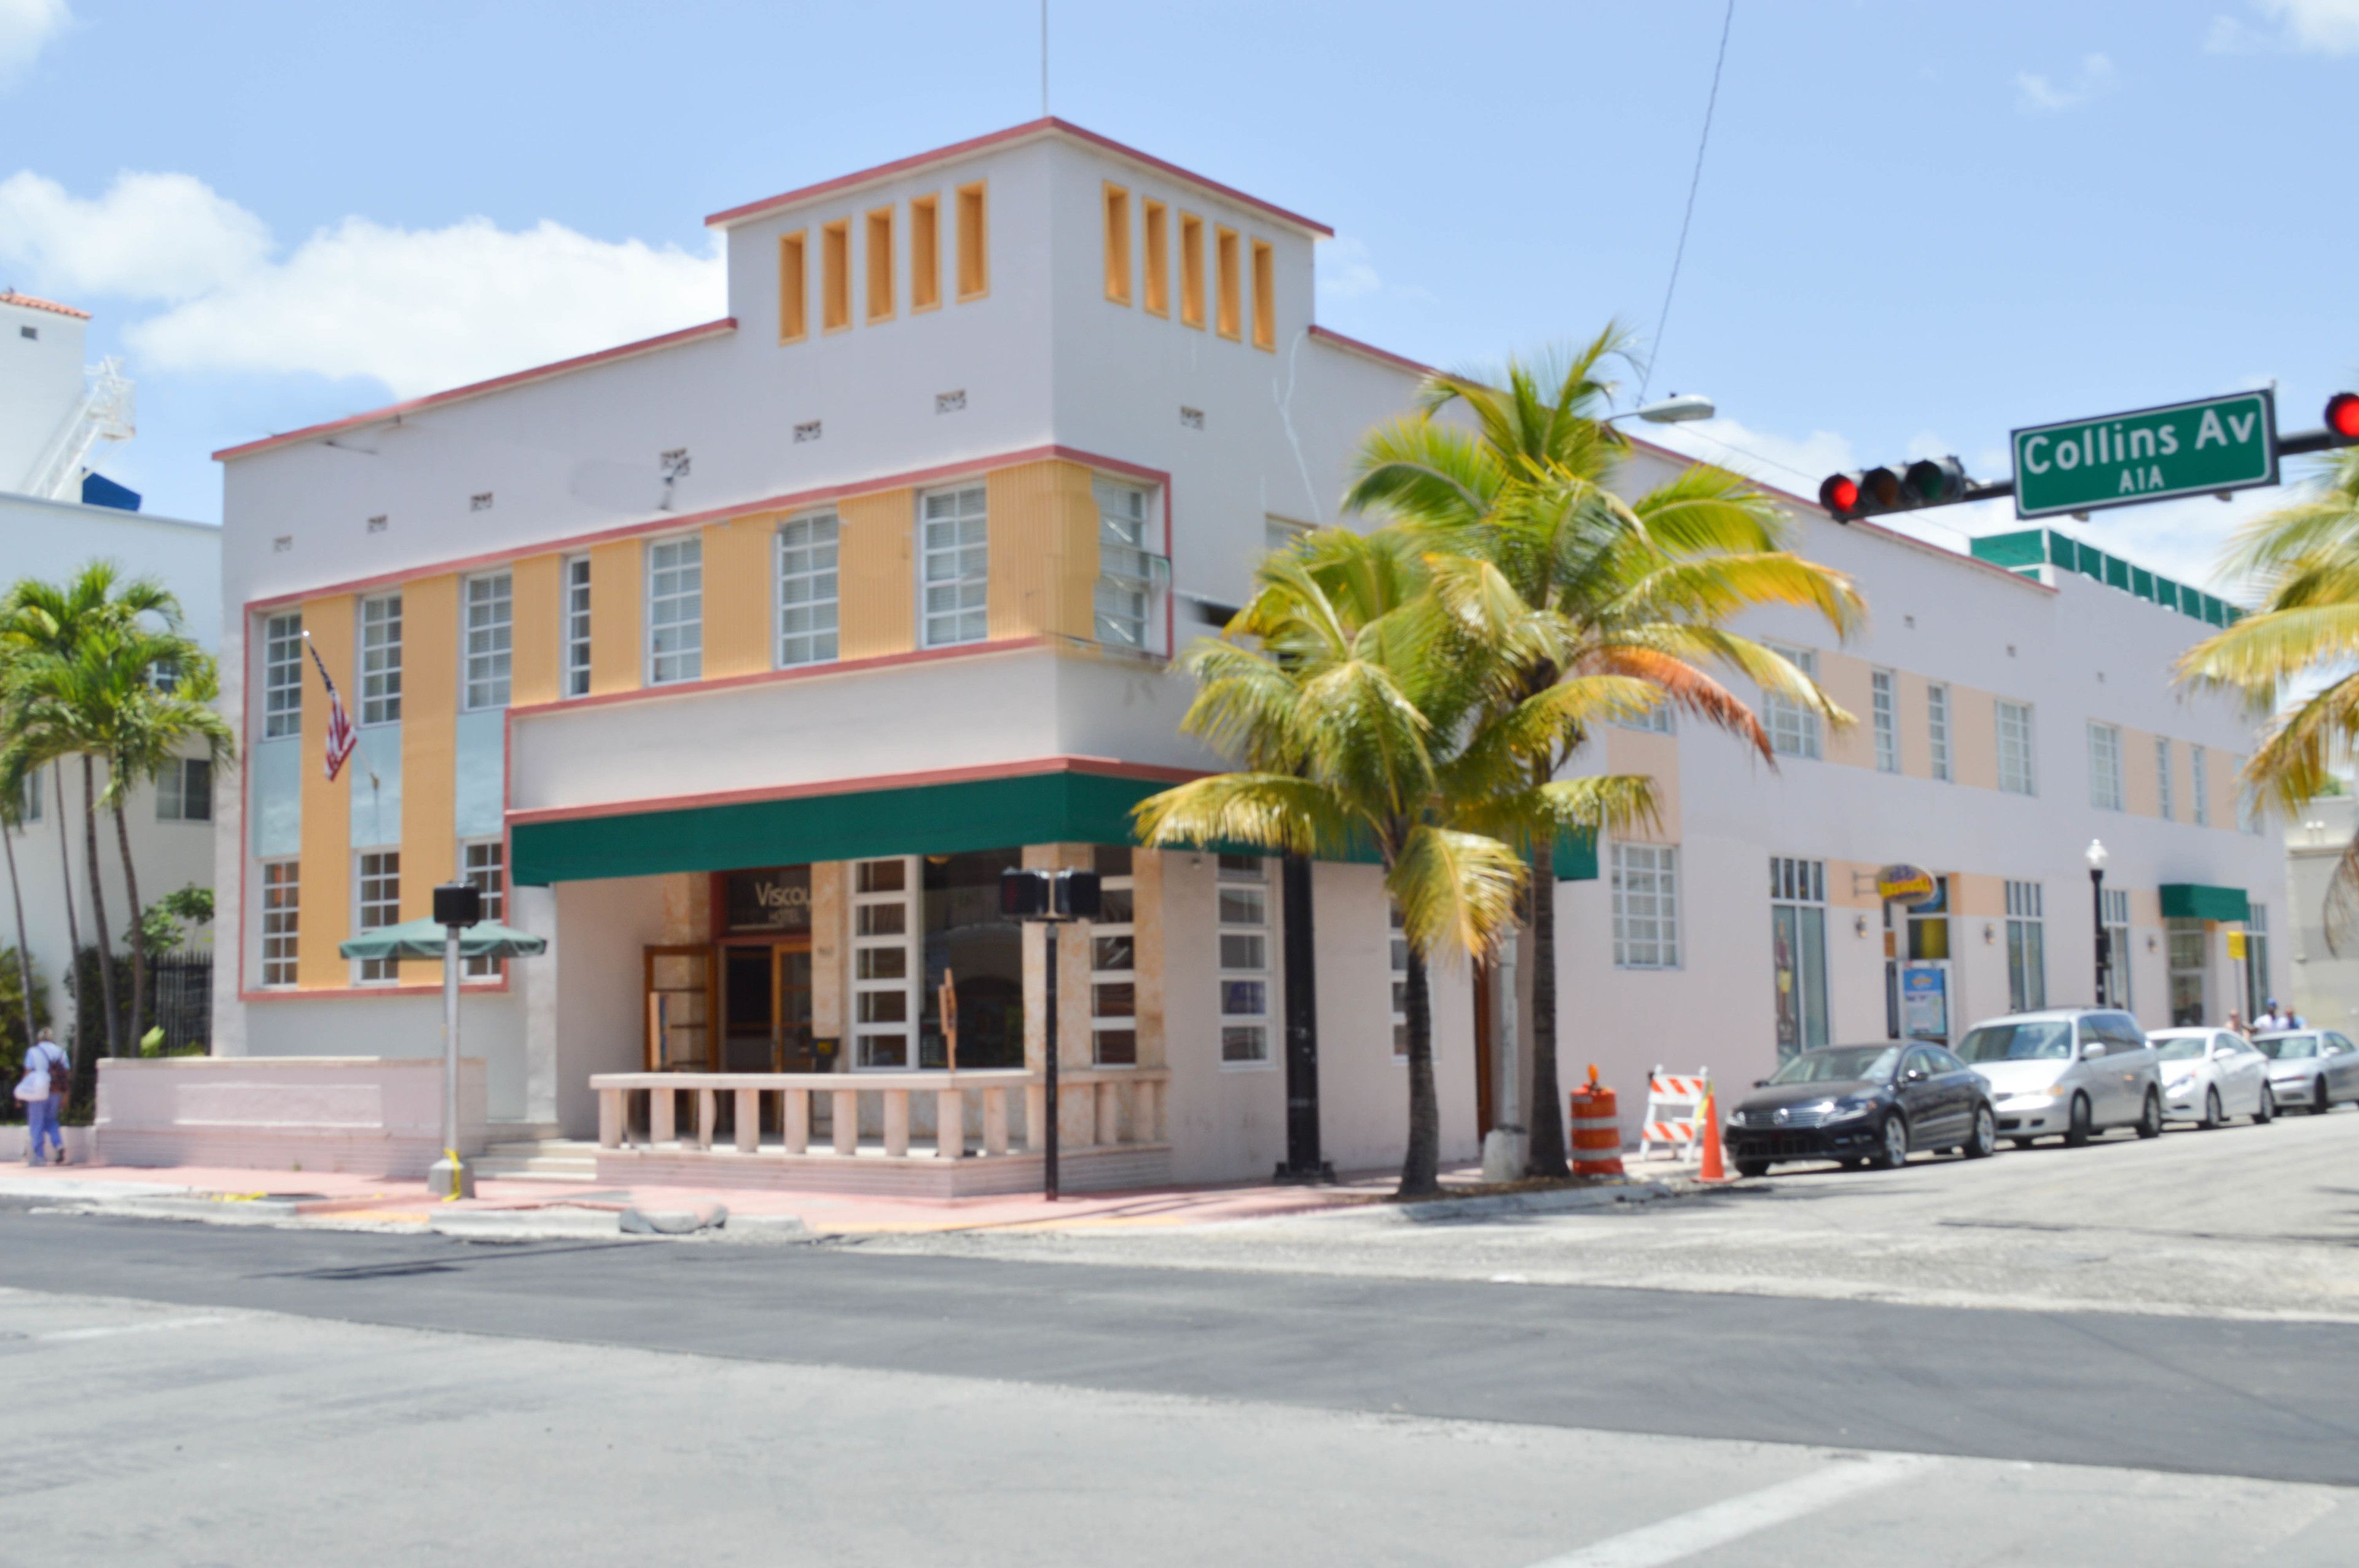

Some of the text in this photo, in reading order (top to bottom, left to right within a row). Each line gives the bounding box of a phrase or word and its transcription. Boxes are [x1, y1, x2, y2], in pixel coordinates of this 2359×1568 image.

[2025, 409, 2256, 475] Collins Av
[2118, 465, 2165, 493] A1A
